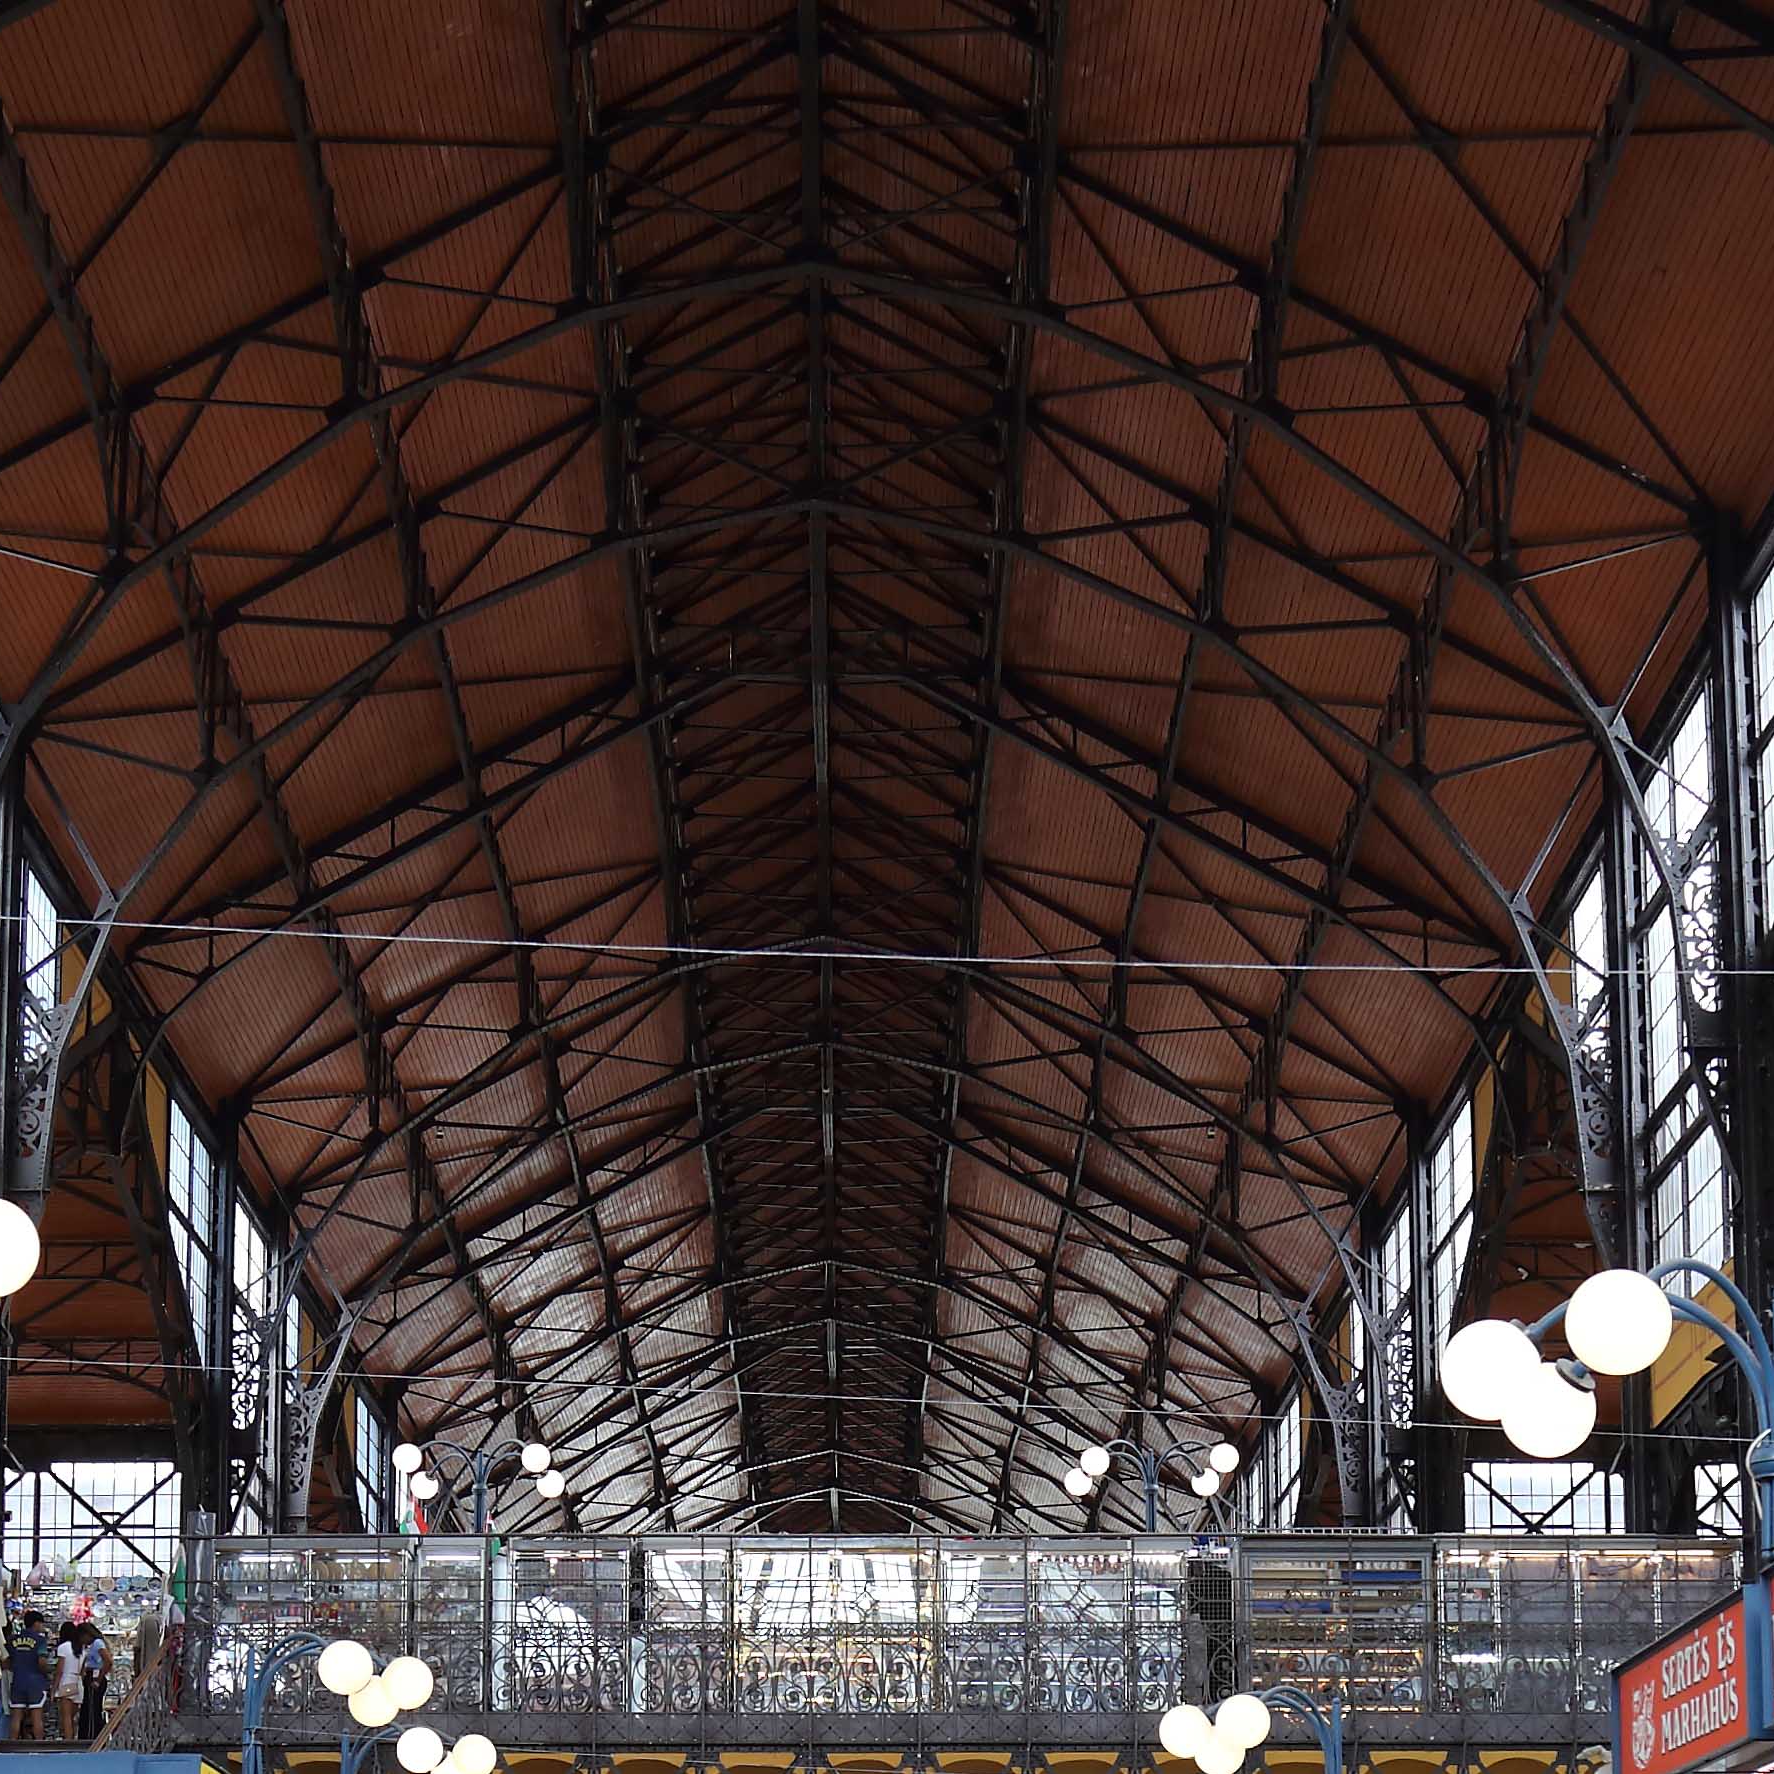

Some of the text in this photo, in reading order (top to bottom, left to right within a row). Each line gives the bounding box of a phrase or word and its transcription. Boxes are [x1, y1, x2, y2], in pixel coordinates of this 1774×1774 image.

[1661, 1612, 1736, 1699] SERTÉS ÉS
[1660, 1669, 1739, 1755] MARHAHÚS
